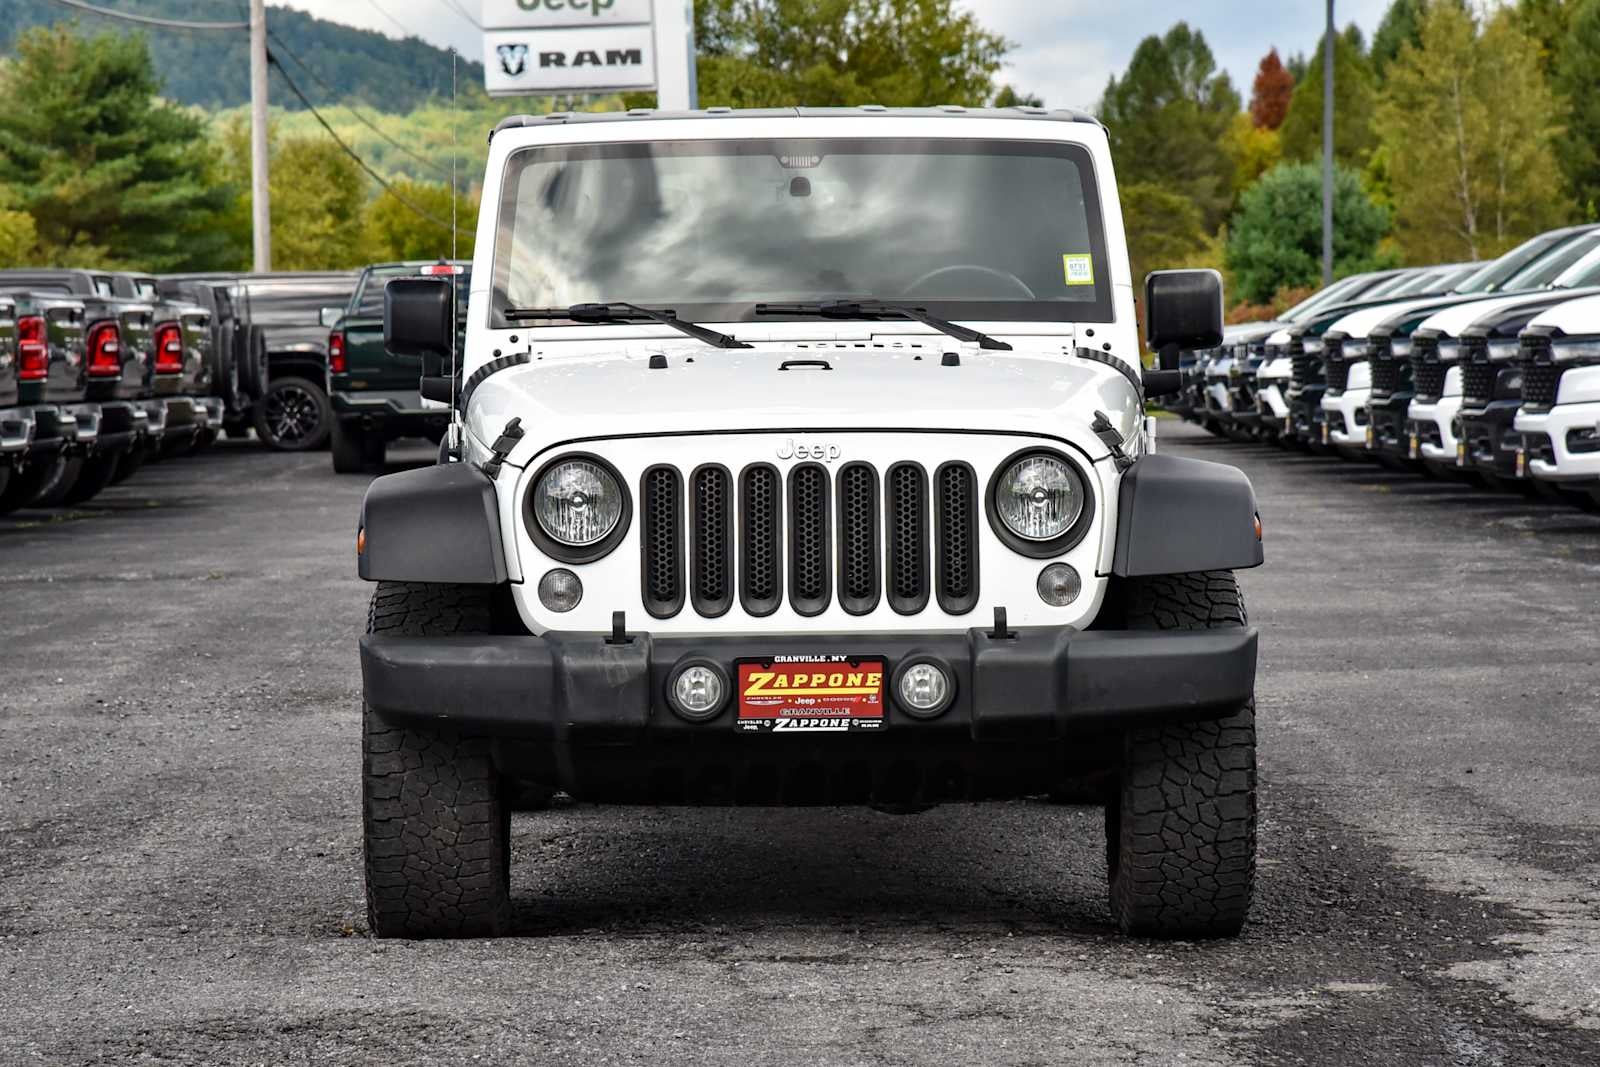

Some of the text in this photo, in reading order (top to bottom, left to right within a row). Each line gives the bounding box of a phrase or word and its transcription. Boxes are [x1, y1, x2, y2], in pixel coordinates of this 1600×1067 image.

[539, 49, 642, 68] RAM
[776, 438, 841, 463] Jeep
[744, 672, 882, 696] ZAPPONE
[795, 697, 816, 706] Jeep
[780, 707, 851, 716] GRANVILLE
[772, 718, 850, 732] ZAPPONE
